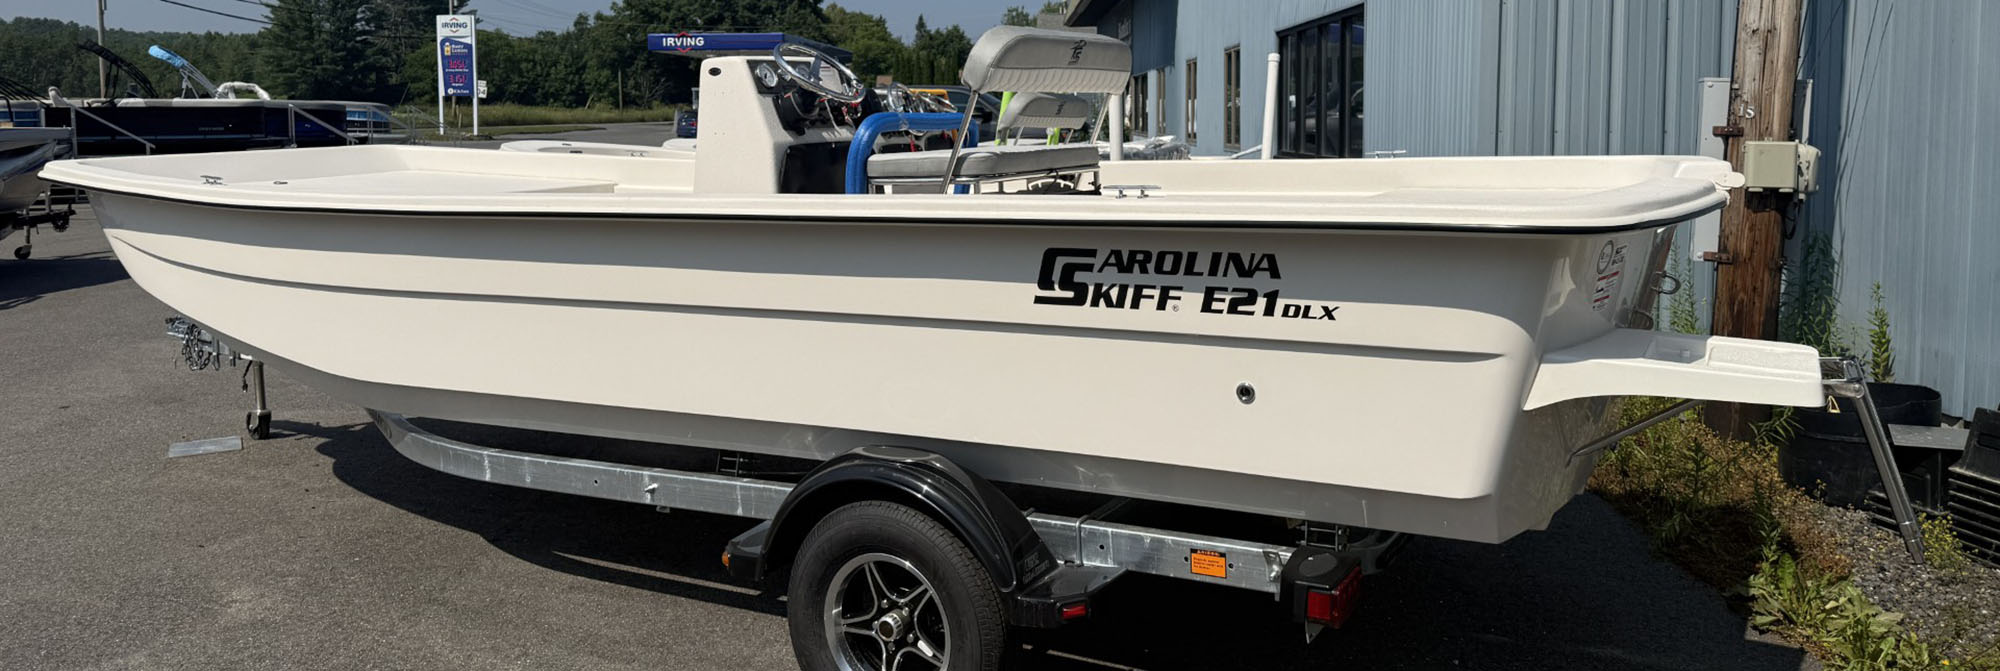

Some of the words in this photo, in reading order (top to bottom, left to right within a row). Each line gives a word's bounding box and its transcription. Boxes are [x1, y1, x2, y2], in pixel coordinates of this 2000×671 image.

[441, 21, 468, 29] IRVING
[662, 37, 705, 47] IRVING
[1738, 103, 1756, 119] 15
[1037, 247, 1282, 292] CAROLINA
